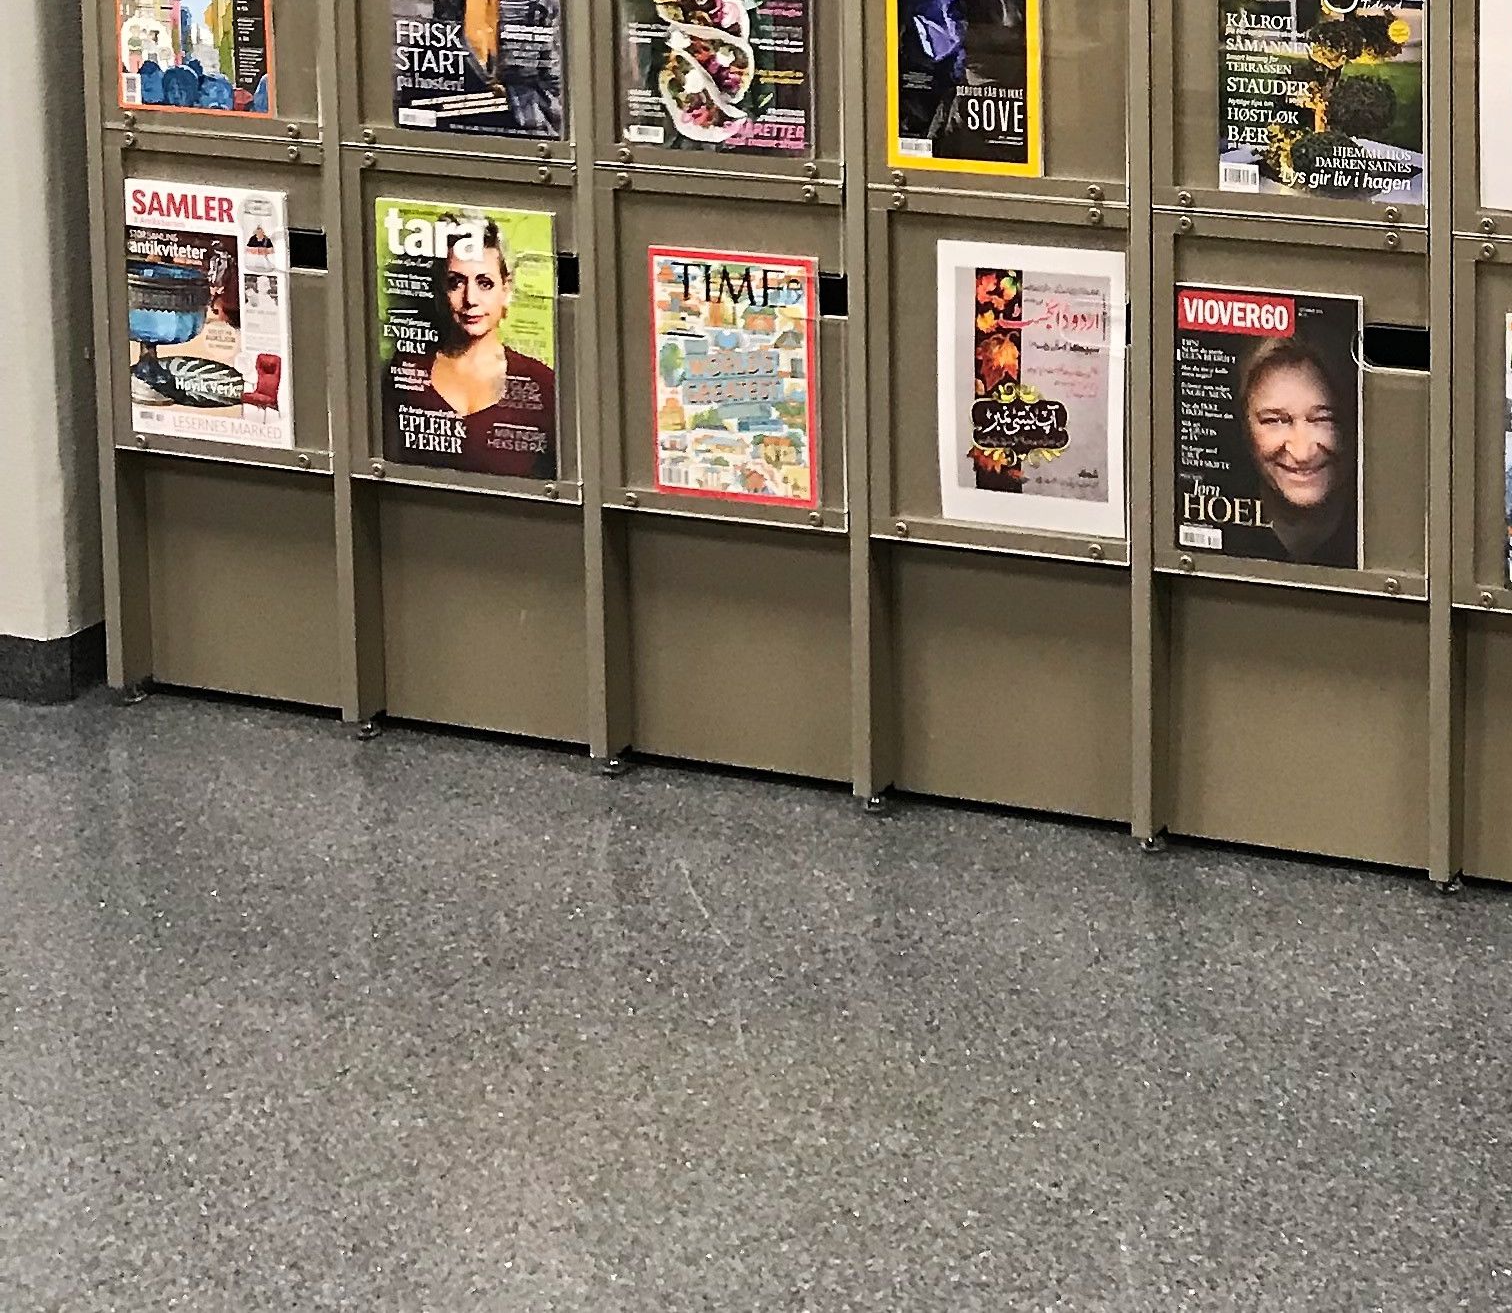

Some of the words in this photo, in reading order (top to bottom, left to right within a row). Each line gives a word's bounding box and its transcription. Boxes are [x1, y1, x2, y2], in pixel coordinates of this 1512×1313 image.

[1226, 7, 1295, 30] KÅLROT
[394, 20, 463, 49] FRISK
[394, 46, 470, 75] START
[1225, 61, 1293, 75] TERRASSEN
[1226, 76, 1313, 98] STAUDER
[967, 98, 1024, 133] SOVE
[1227, 107, 1299, 125] HØSTLØK
[1227, 125, 1271, 144] BÆR
[1315, 156, 1367, 171] DARREN
[1367, 160, 1413, 173] SAINES
[1281, 170, 1307, 187] Lys
[1309, 169, 1332, 189] gir
[1334, 170, 1352, 187] liv
[1354, 175, 1360, 188] i
[1363, 174, 1412, 193] hagen
[132, 189, 235, 224] SAMLER
[384, 207, 488, 262] tara
[128, 239, 208, 262] antikviteter
[671, 261, 788, 309] TIME
[383, 324, 439, 343] ENDELIG
[173, 414, 230, 435] LESERNES
[231, 419, 282, 439] MARKED
[399, 413, 453, 438] EPLER
[454, 418, 467, 439] &
[404, 431, 464, 455] PÆRER
[1183, 492, 1274, 529] HOEL
